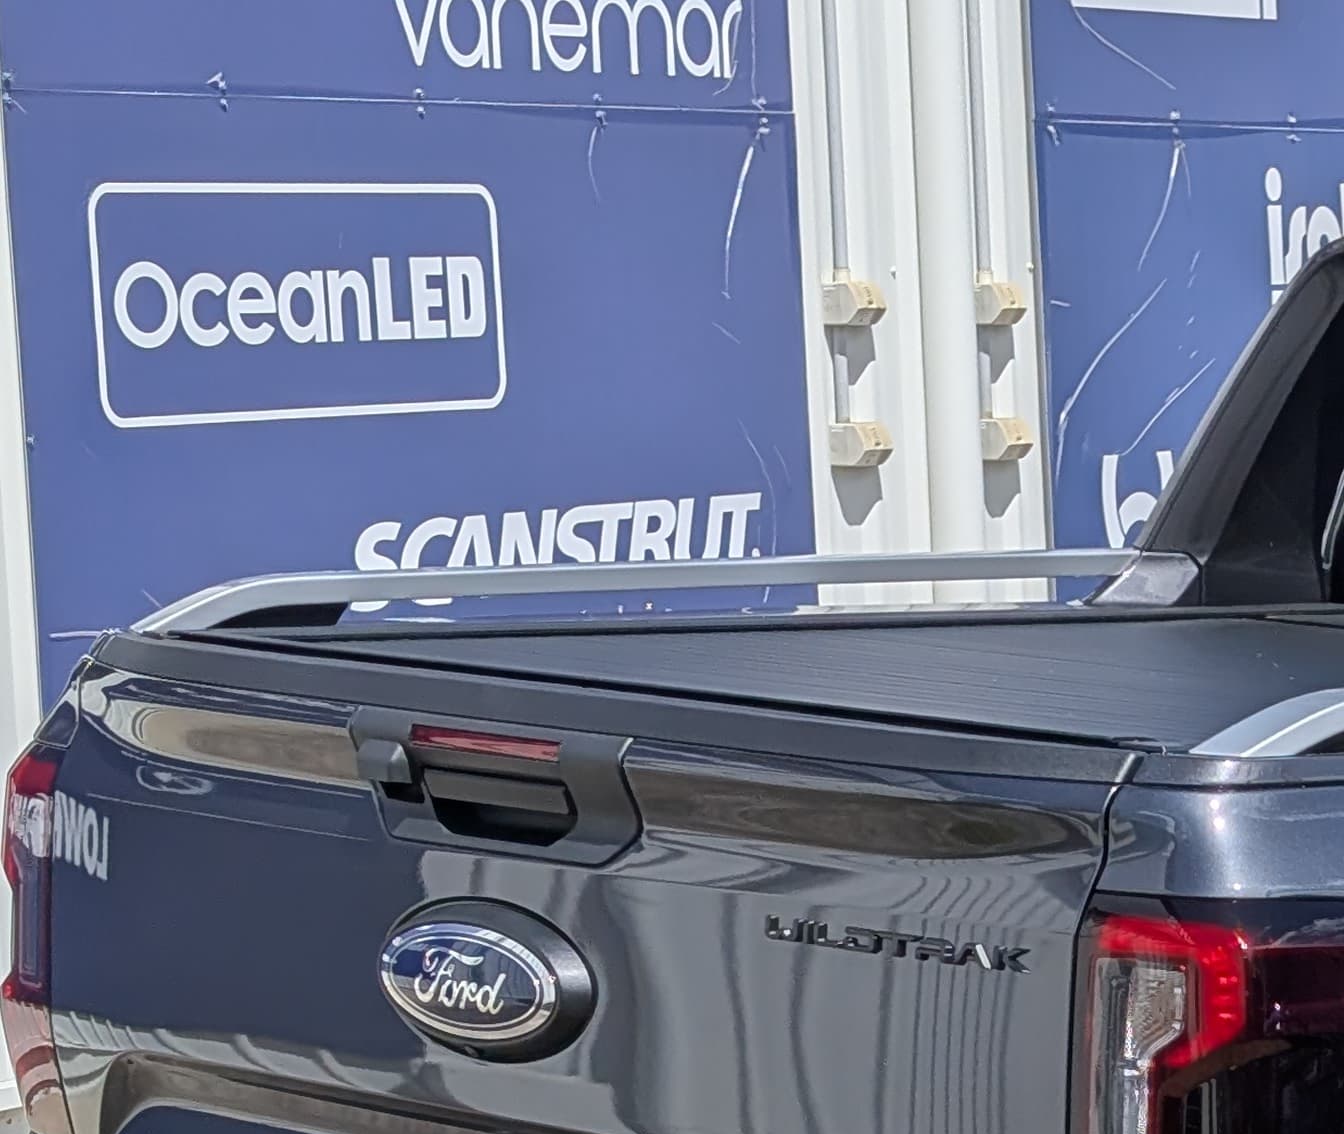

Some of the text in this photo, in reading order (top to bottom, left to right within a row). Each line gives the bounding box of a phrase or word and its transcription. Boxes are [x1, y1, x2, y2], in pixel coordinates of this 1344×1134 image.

[114, 255, 488, 350] OceanLED
[765, 914, 1032, 974] WILDTRAK
[413, 947, 507, 1015] Ford
